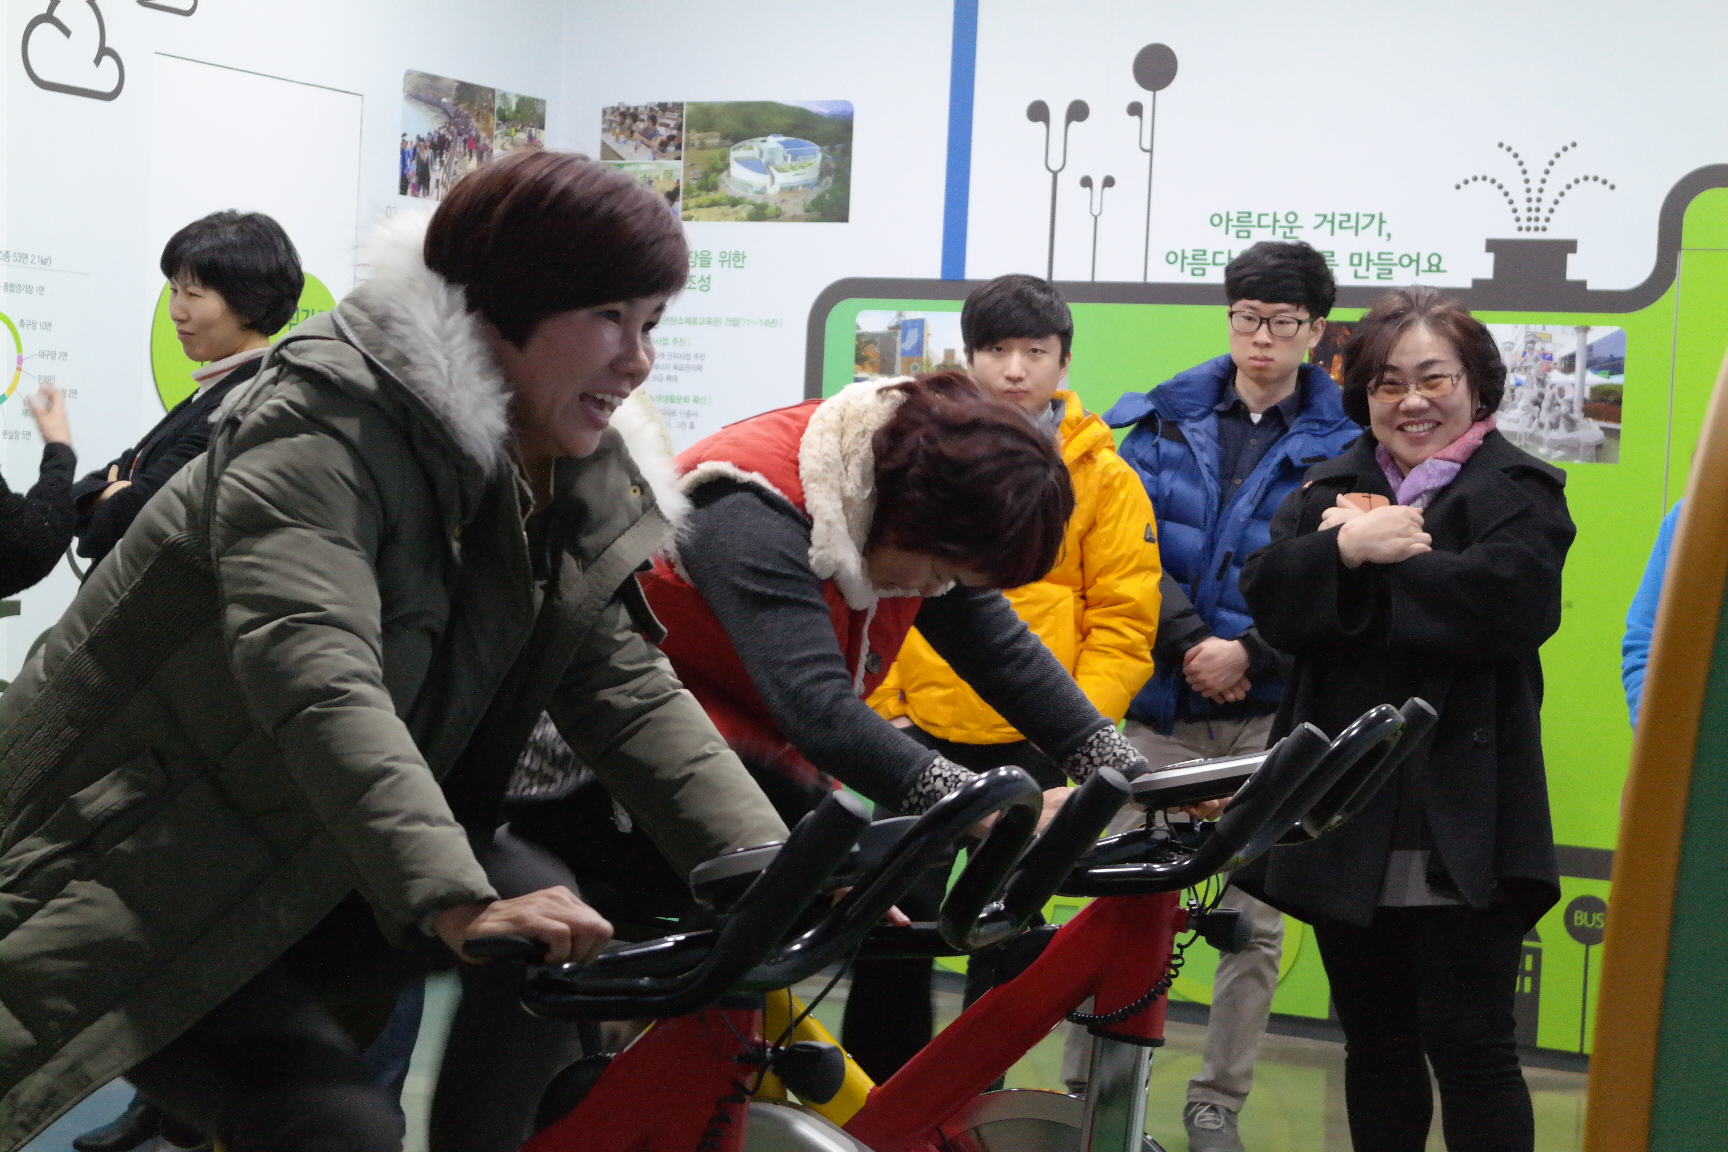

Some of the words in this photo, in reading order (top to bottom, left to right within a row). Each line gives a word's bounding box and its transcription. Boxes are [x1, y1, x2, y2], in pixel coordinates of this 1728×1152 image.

[1209, 211, 1304, 240] 아름다운
[1312, 211, 1392, 242] 거리가,
[718, 250, 747, 269] 위한
[1165, 249, 1248, 277] 아름다
[1349, 250, 1448, 281] 만들어요
[3, 281, 34, 295] 종합경기장
[36, 285, 45, 296] 1면
[19, 318, 37, 331] 축구장
[39, 321, 52, 331] 10면
[38, 349, 57, 361] 야구장
[58, 351, 68, 361] 2면
[68, 388, 78, 399] 2면
[21, 430, 32, 441] 5면
[1574, 909, 1605, 929] BUS
